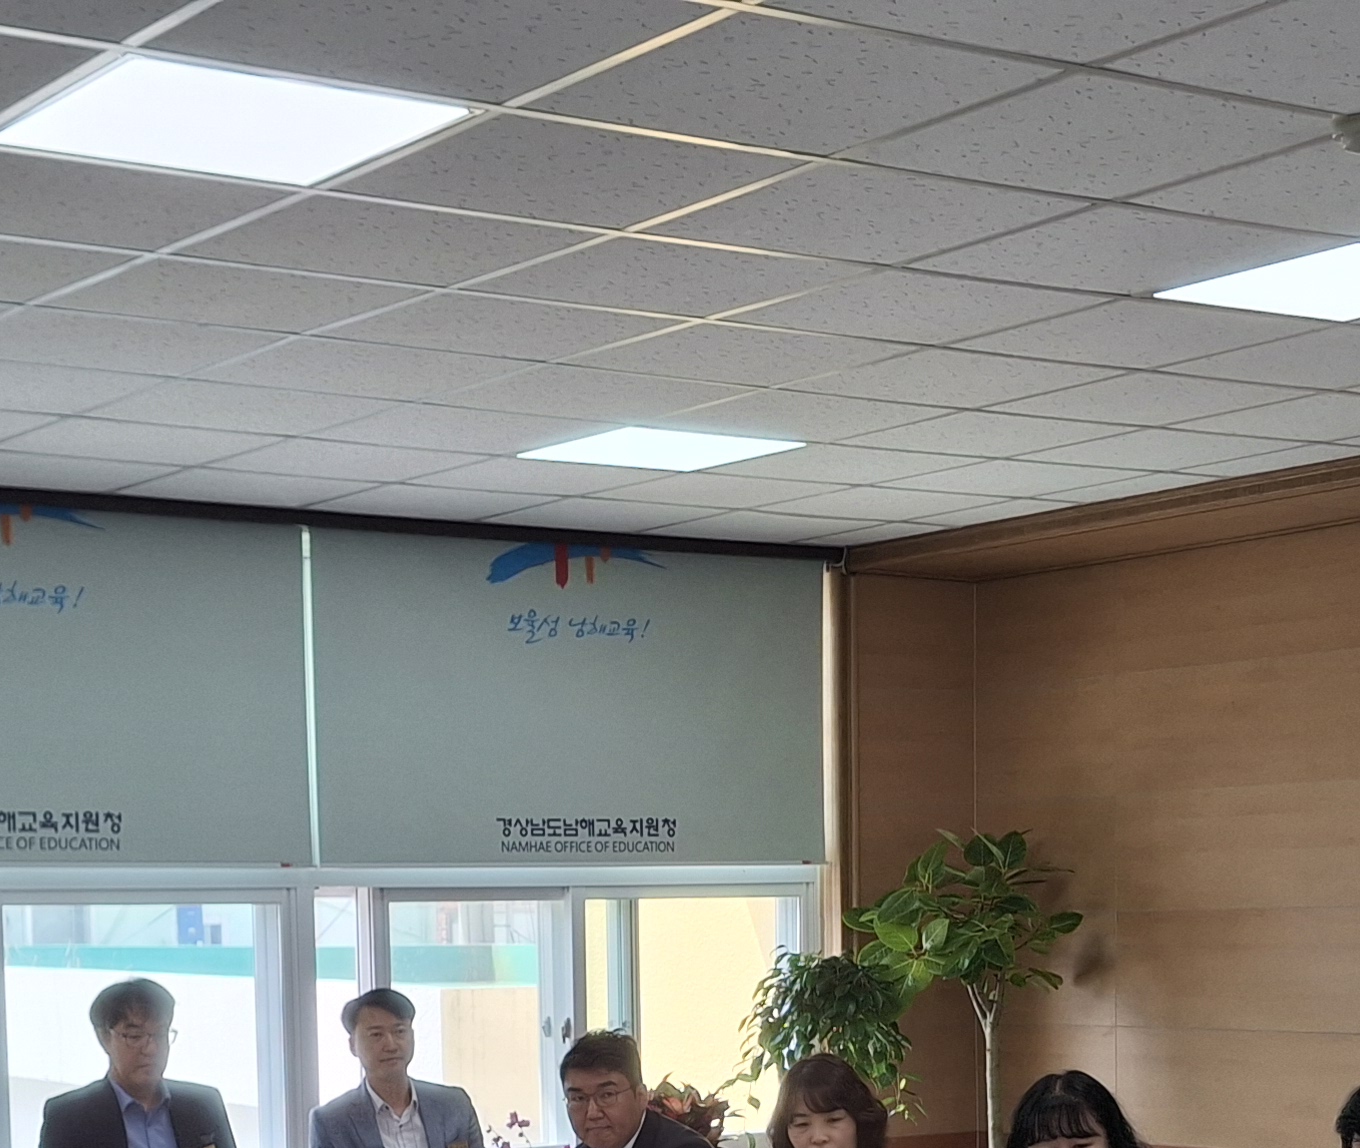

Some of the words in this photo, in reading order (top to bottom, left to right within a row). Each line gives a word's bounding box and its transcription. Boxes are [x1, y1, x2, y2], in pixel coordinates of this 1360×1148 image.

[496, 817, 677, 838] 경상남도남해교육지원청
[16, 836, 36, 850] OF
[40, 836, 120, 850] EDUCATION
[501, 840, 552, 853] NAMHAE
[554, 840, 592, 853] OFFICE
[594, 840, 610, 853] OF
[613, 840, 675, 853] EDUCATION
